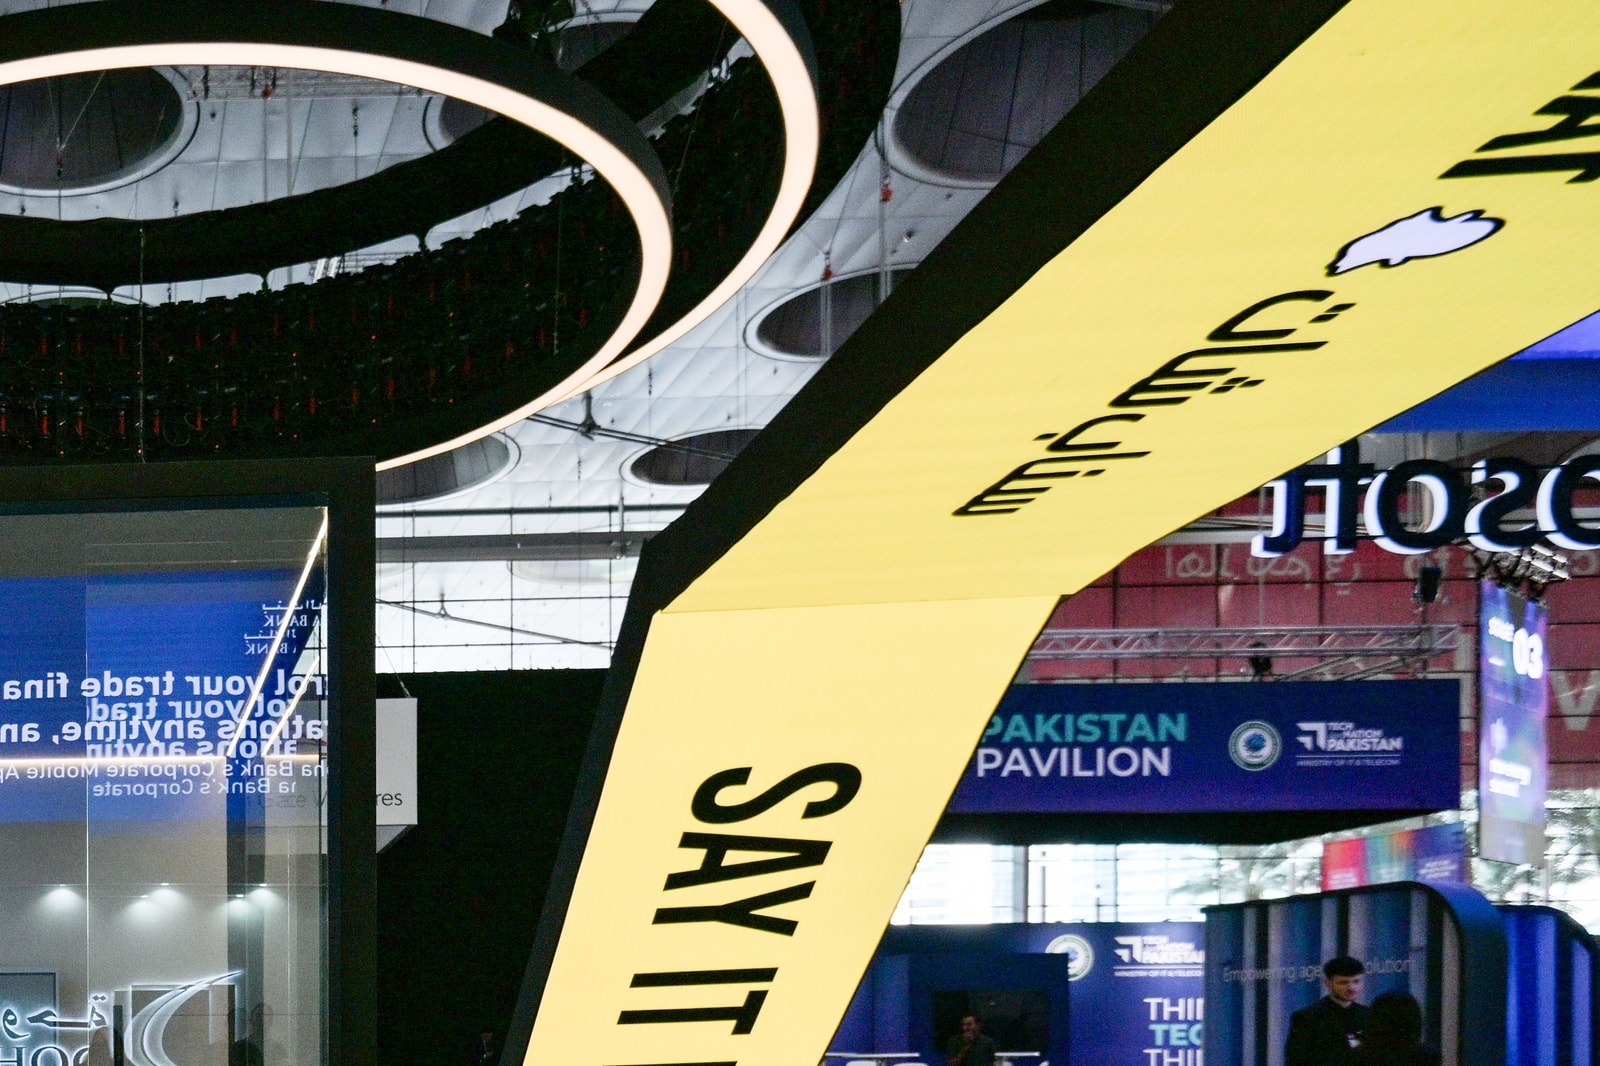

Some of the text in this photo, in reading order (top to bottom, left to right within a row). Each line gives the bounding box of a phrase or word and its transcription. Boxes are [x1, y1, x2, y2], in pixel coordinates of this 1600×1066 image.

[982, 711, 1189, 744] PAKISTAN
[1327, 737, 1403, 752] PAKISTAN
[976, 746, 1171, 778] PAVILION
[651, 761, 863, 937] SAY
[616, 966, 780, 1036] IT
